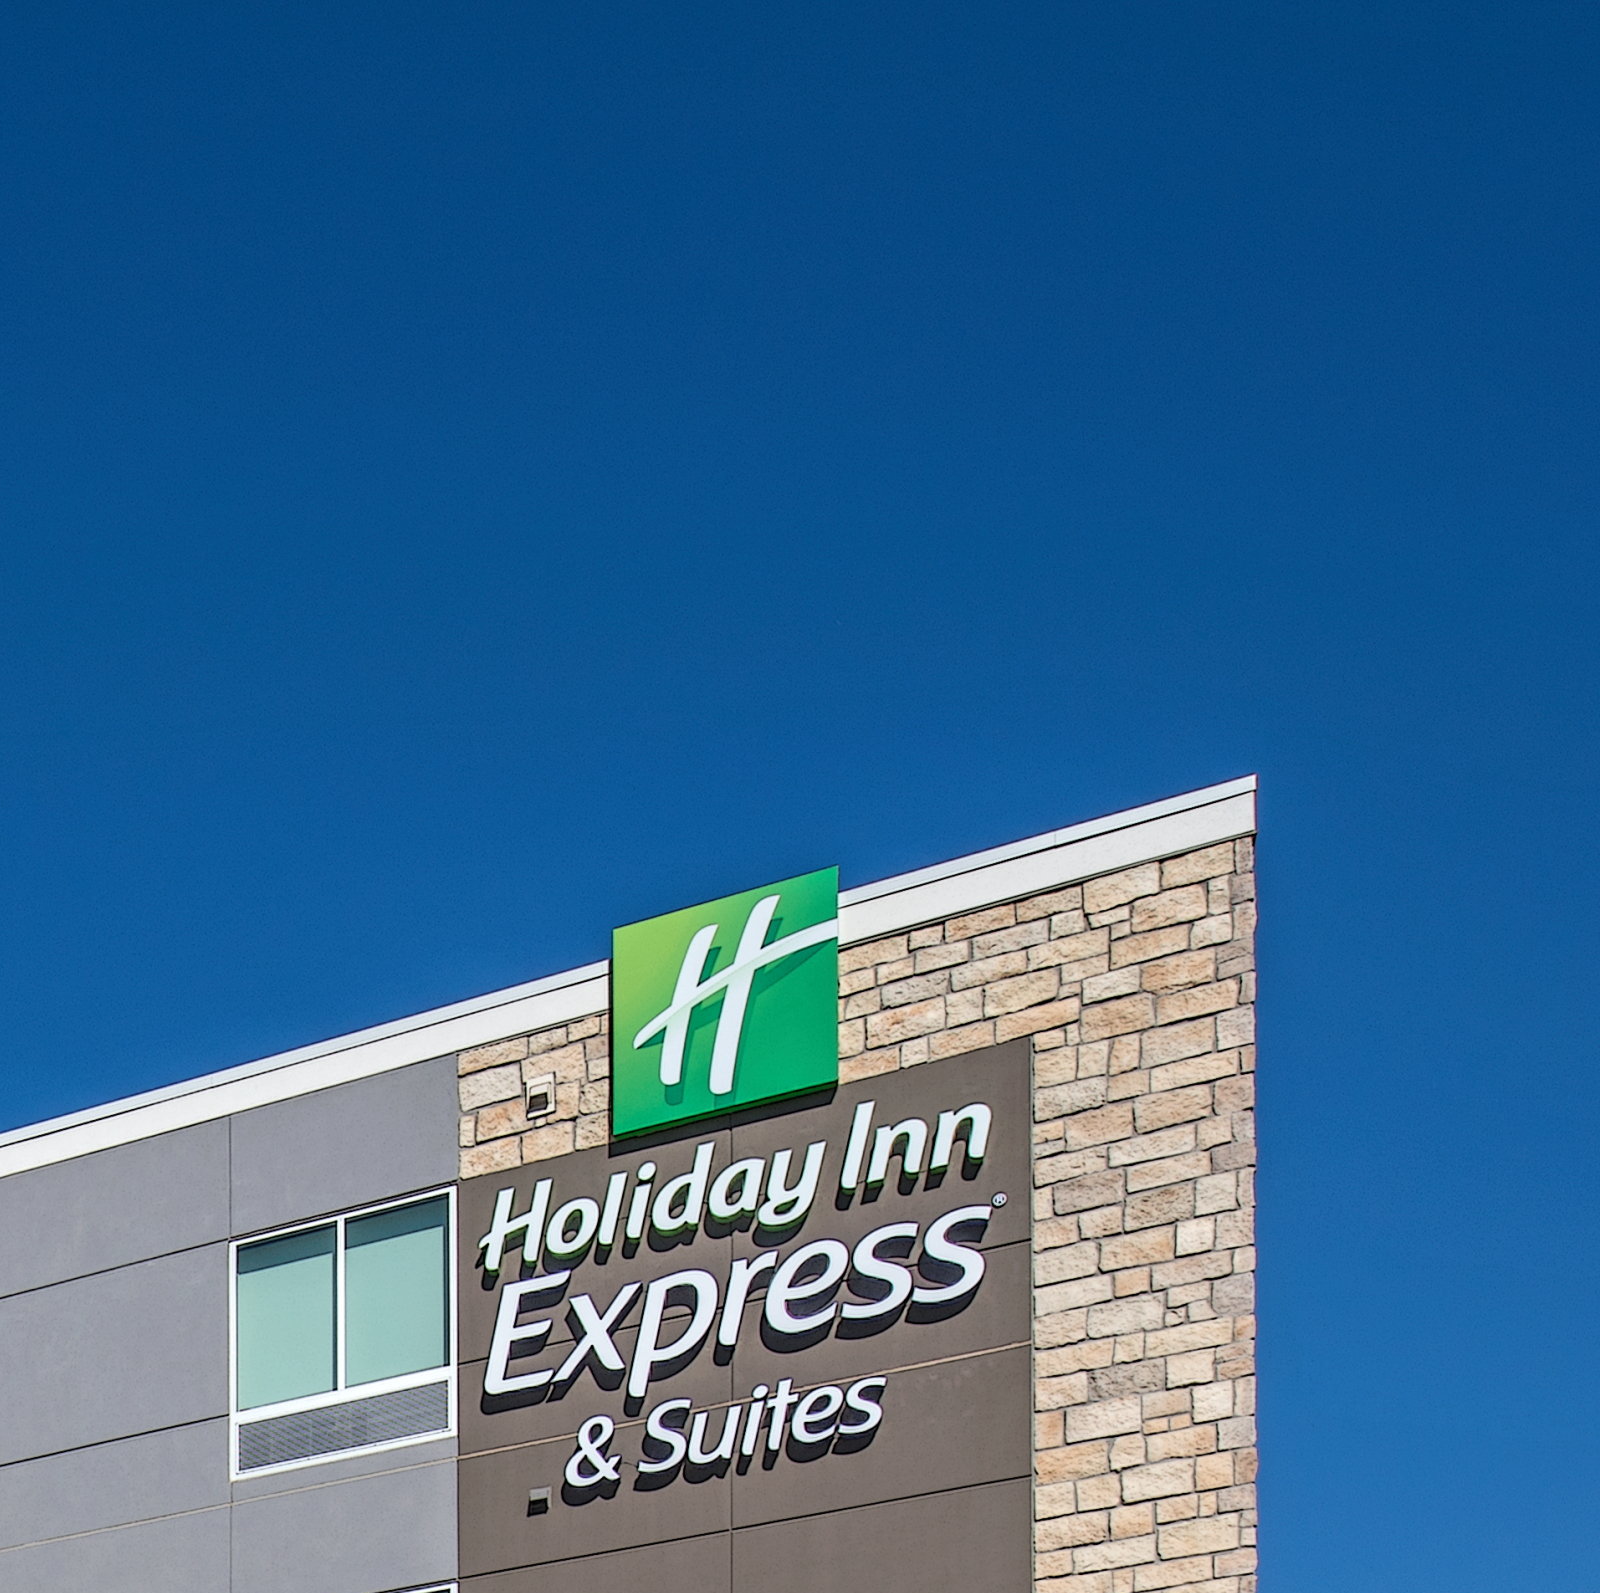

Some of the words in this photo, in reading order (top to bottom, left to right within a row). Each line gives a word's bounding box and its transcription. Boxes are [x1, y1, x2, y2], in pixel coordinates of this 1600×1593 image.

[479, 1140, 827, 1273] Holiday
[840, 1100, 992, 1192] Inn
[483, 1205, 993, 1398] Express
[564, 1415, 621, 1488] &
[637, 1376, 887, 1474] Suites
